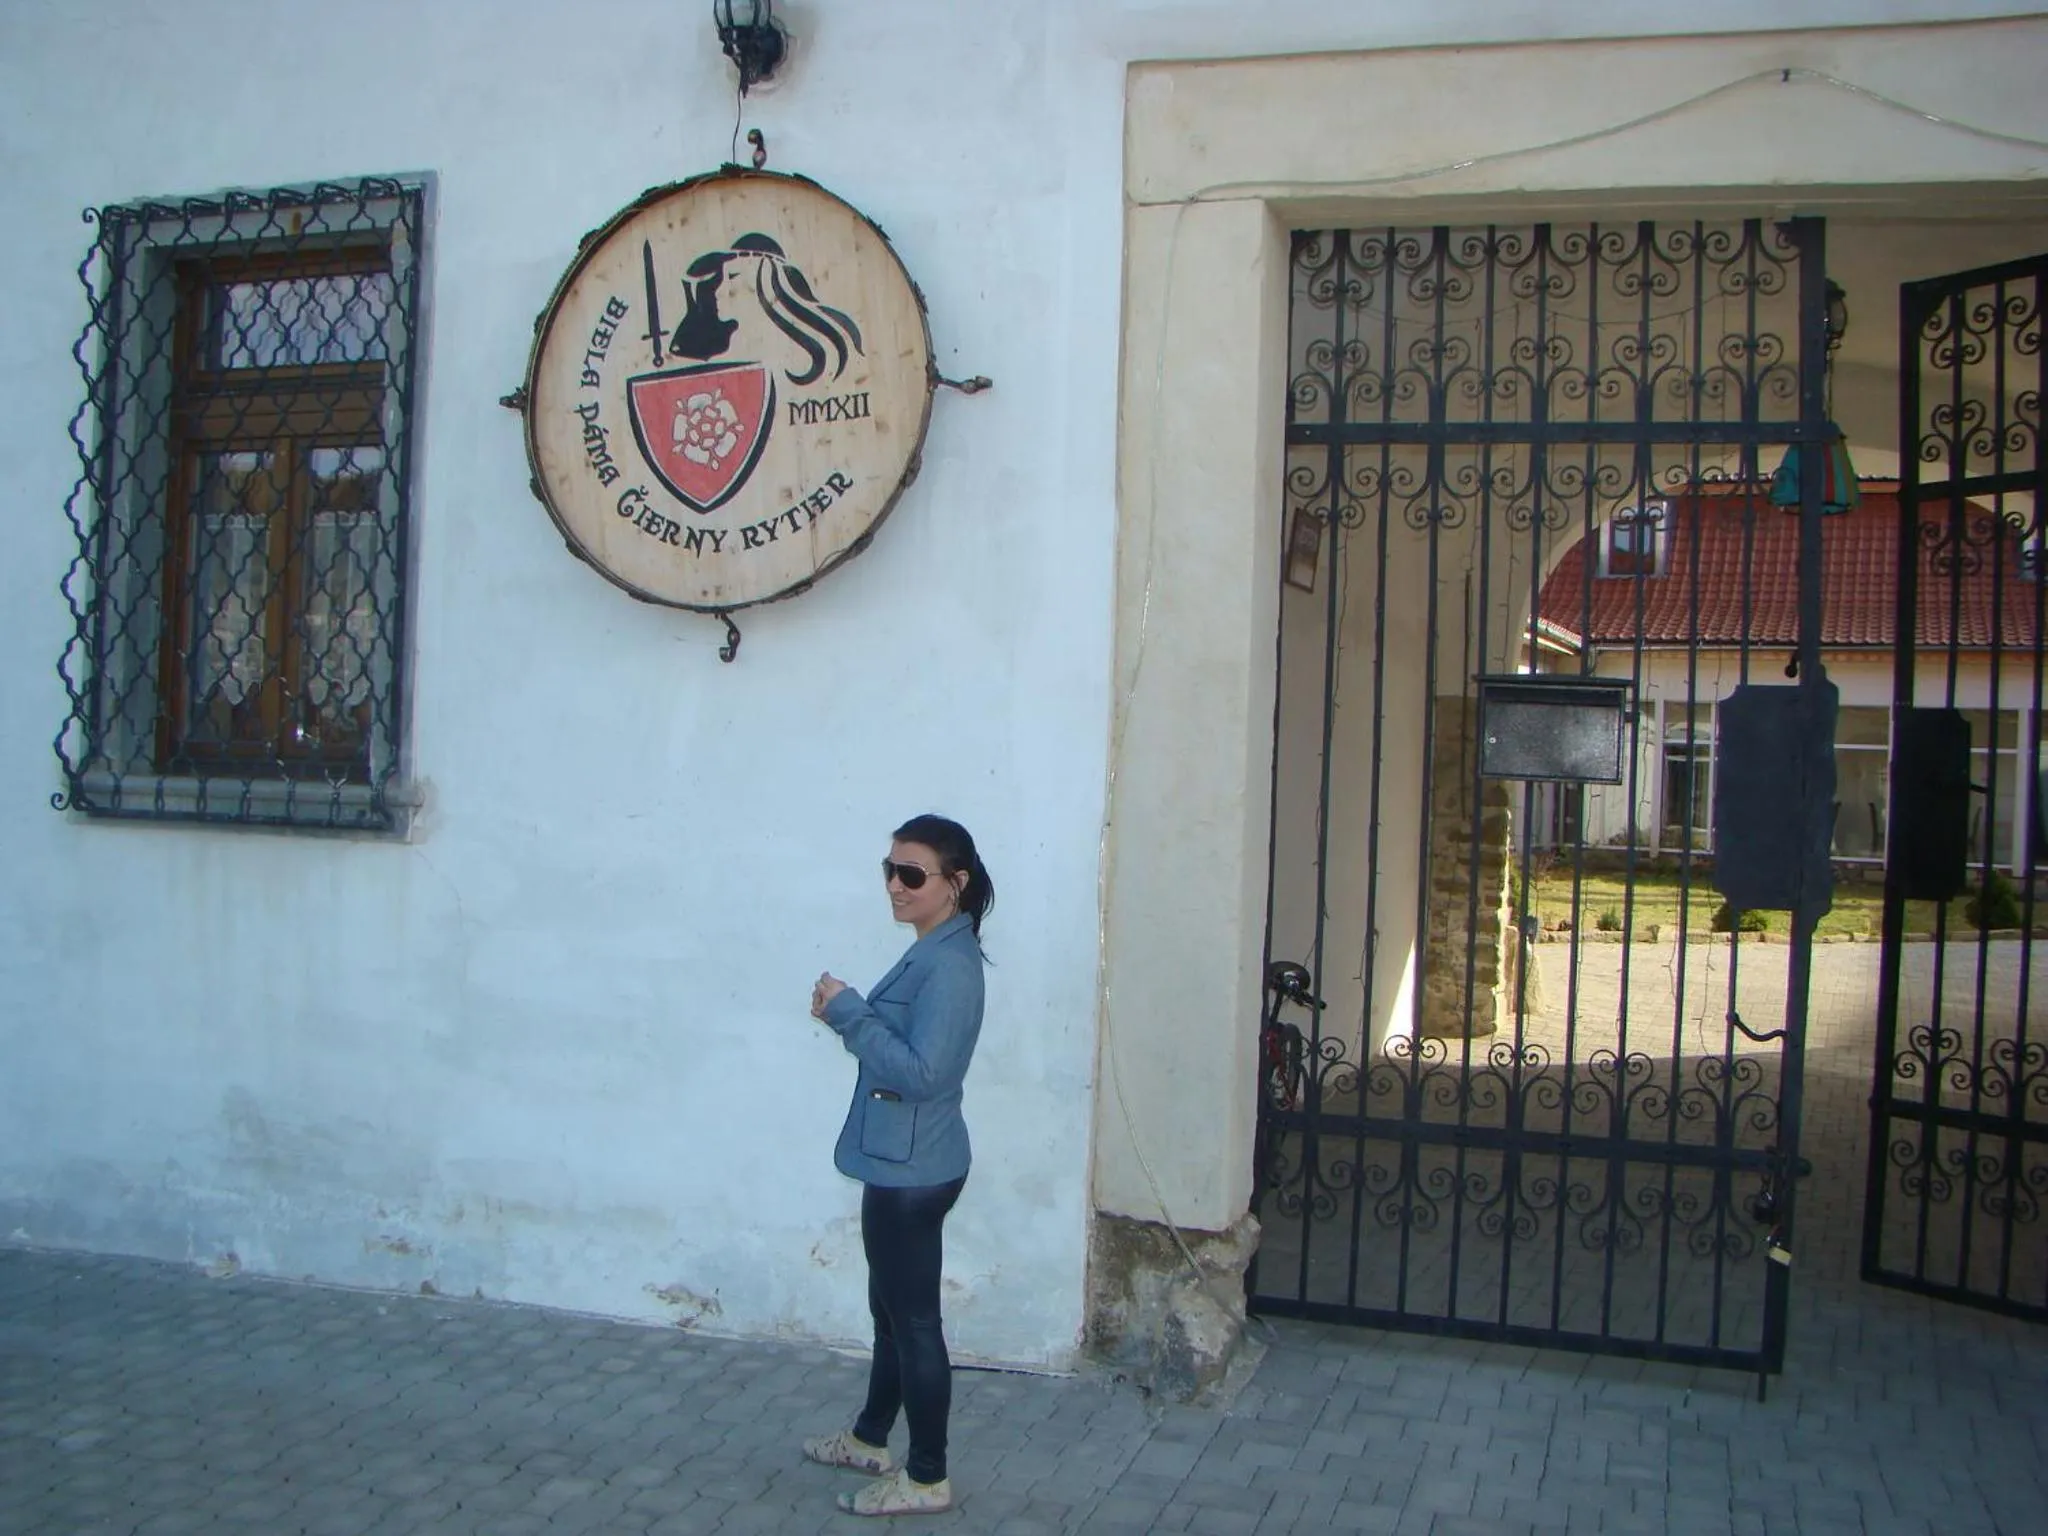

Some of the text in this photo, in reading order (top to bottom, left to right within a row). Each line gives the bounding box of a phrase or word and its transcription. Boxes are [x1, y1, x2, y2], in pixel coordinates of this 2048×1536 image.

[580, 296, 629, 391] BIELA
[574, 402, 621, 488] DÁMA
[788, 392, 870, 426] MMXII
[741, 472, 853, 550] RYTIER
